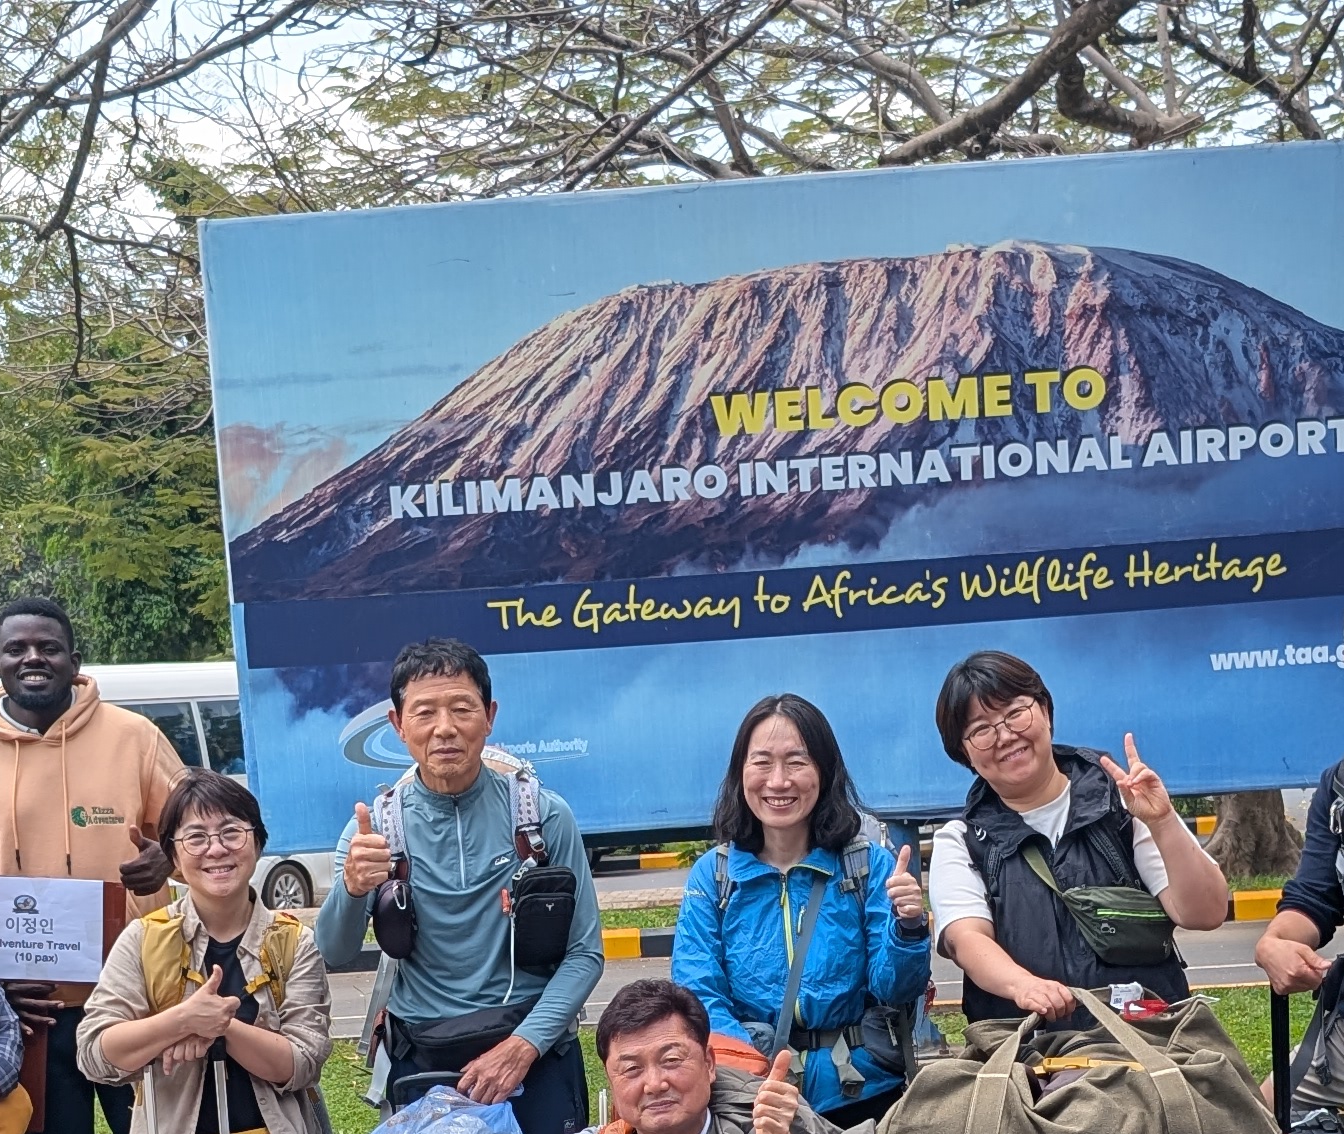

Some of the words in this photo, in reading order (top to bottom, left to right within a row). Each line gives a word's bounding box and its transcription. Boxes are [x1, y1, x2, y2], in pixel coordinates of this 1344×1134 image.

[709, 372, 1014, 437] WELCOME
[1024, 366, 1106, 414] TO
[389, 463, 728, 520] KILIMANJARO
[738, 433, 1133, 498] INTERNATIONAL
[487, 597, 562, 631] The
[573, 583, 741, 634] Gateway
[753, 576, 791, 615] to
[802, 568, 949, 618] Africa's
[1124, 541, 1288, 593] Heritage
[537, 737, 589, 754] Authority
[5, 916, 55, 935] 이정인
[46, 939, 81, 952] Travel
[14, 952, 33, 964] (10
[34, 952, 59, 965] pax)
